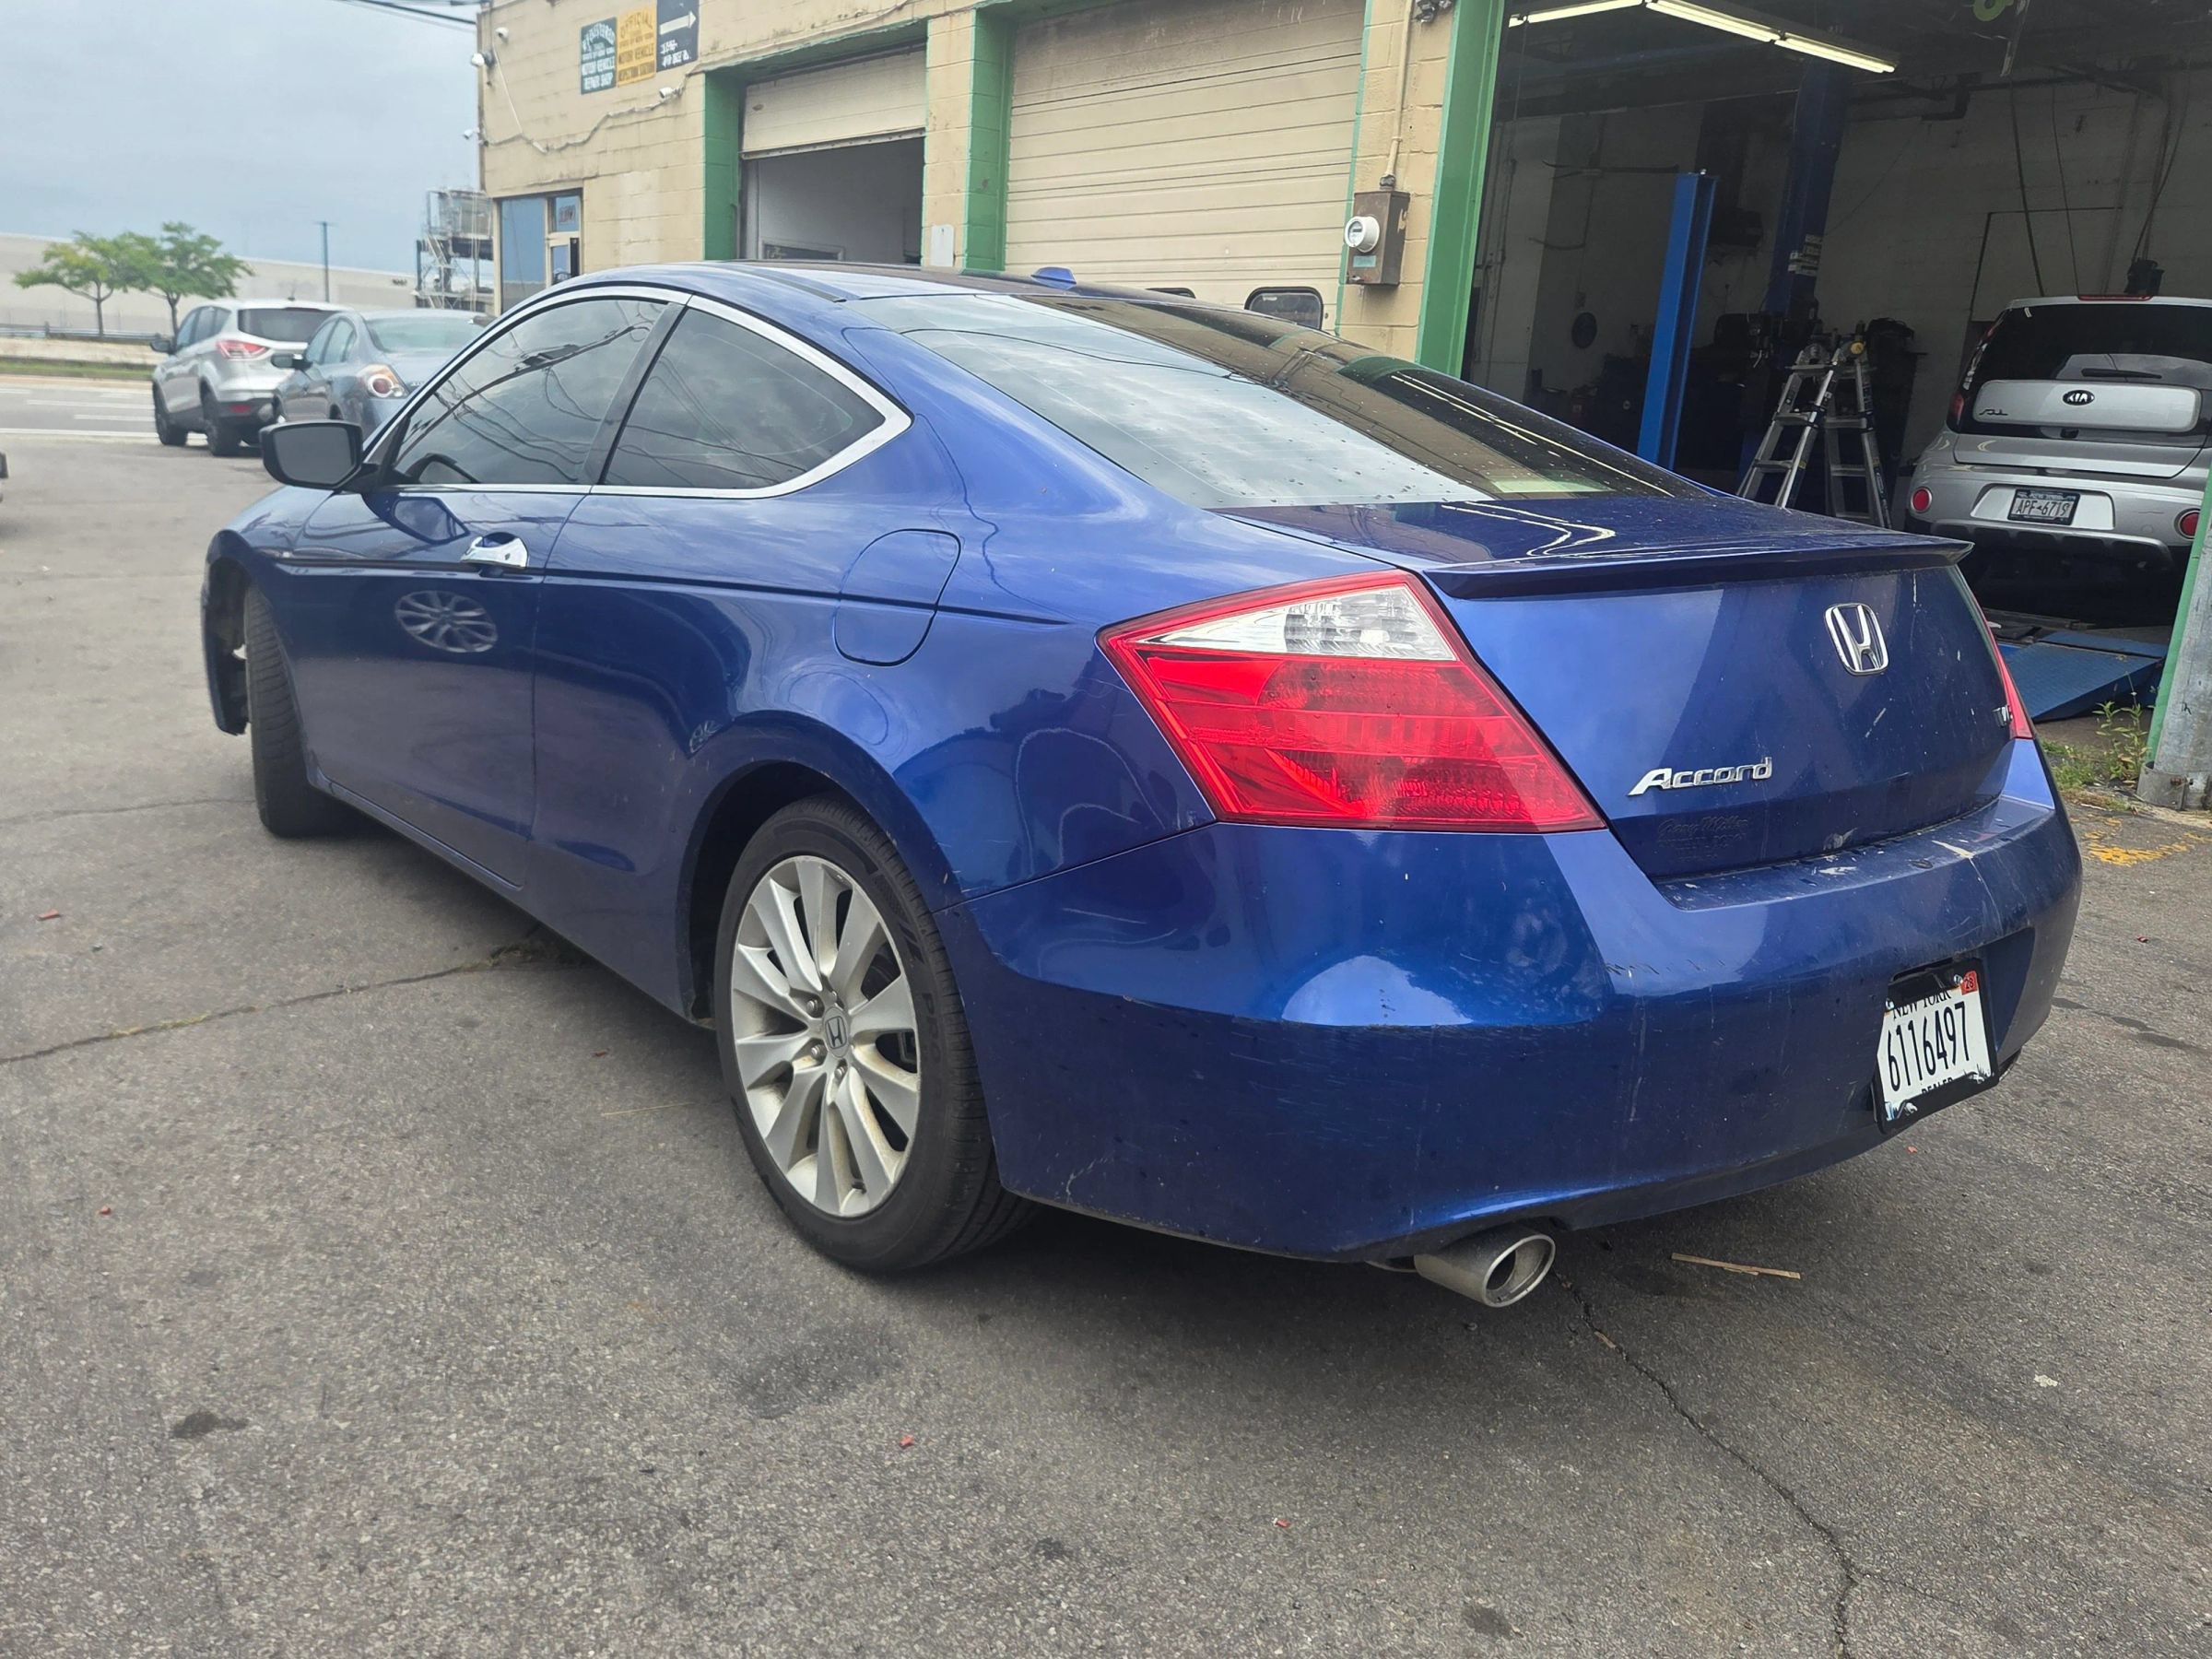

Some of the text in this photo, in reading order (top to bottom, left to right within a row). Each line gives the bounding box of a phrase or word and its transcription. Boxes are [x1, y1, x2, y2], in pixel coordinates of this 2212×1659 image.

[2067, 393, 2088, 403] KIA
[1628, 757, 1772, 795] Accord
[1888, 1001, 1970, 1091] 6116497
